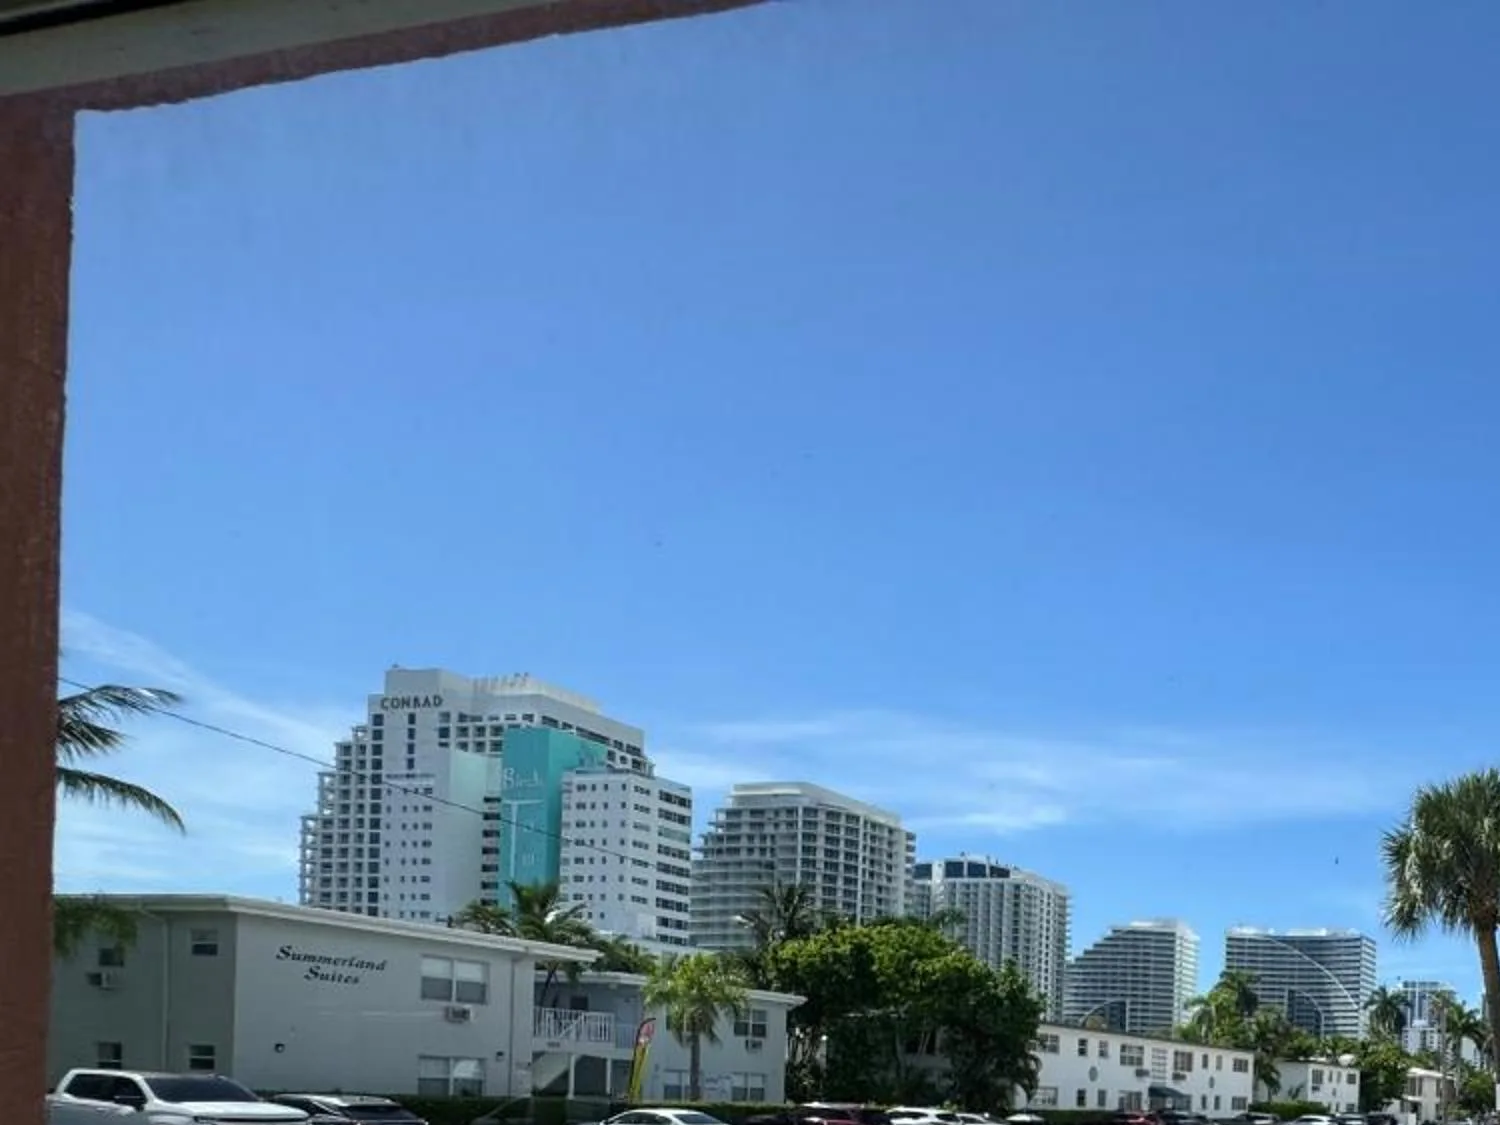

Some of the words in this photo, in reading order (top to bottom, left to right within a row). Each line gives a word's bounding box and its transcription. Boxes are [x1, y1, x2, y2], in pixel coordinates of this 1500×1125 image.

[381, 695, 443, 711] CONRAD
[276, 944, 388, 971] Summerland
[304, 965, 360, 985] Suites
